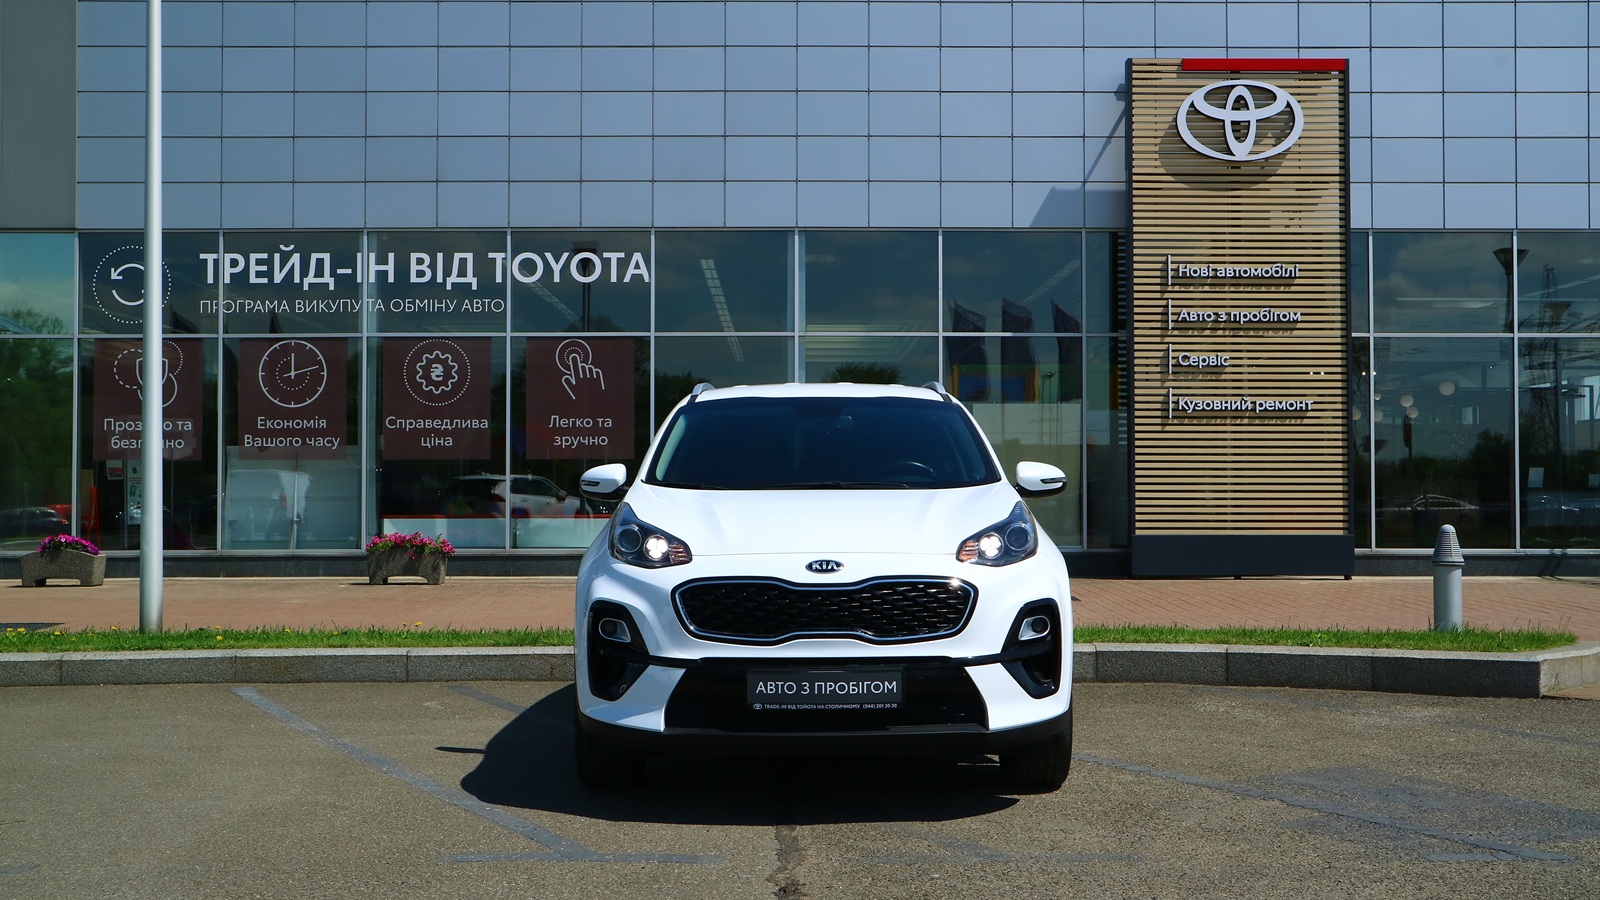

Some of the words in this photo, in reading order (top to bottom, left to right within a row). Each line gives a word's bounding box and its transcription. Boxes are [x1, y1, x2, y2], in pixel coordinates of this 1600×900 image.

[200, 244, 395, 291] ТРЕЙД-ІН
[409, 252, 478, 290] ВІД
[487, 251, 651, 283] TOYOTA
[1178, 263, 1212, 277] Нові
[1216, 263, 1299, 278] автомобілі
[200, 299, 290, 313] ПРОГРАМА
[295, 299, 362, 313] ВИКУПУ
[366, 298, 385, 312] ТА
[390, 299, 457, 312] ОБМІНУ
[461, 299, 505, 312] АВТО
[1178, 308, 1214, 321] Авто
[1218, 311, 1227, 321] з
[1230, 308, 1301, 325] пробігом
[1178, 353, 1230, 368] Сервіс
[1178, 396, 1252, 413] Кузовний
[1255, 400, 1313, 413] ремонт
[104, 418, 172, 433] Прозо
[177, 421, 192, 430] та
[257, 416, 327, 429] Економія
[385, 416, 489, 431] Справедлива
[549, 415, 593, 427] Легко
[597, 418, 612, 427] та
[111, 435, 184, 448] безно
[244, 435, 302, 447] Вашого
[306, 437, 340, 449] часу
[421, 434, 453, 448] ціна
[553, 437, 608, 448] зручно
[811, 560, 838, 570] KIA
[755, 681, 797, 694] АВТО
[814, 681, 897, 694] ПРОБІГОМ
